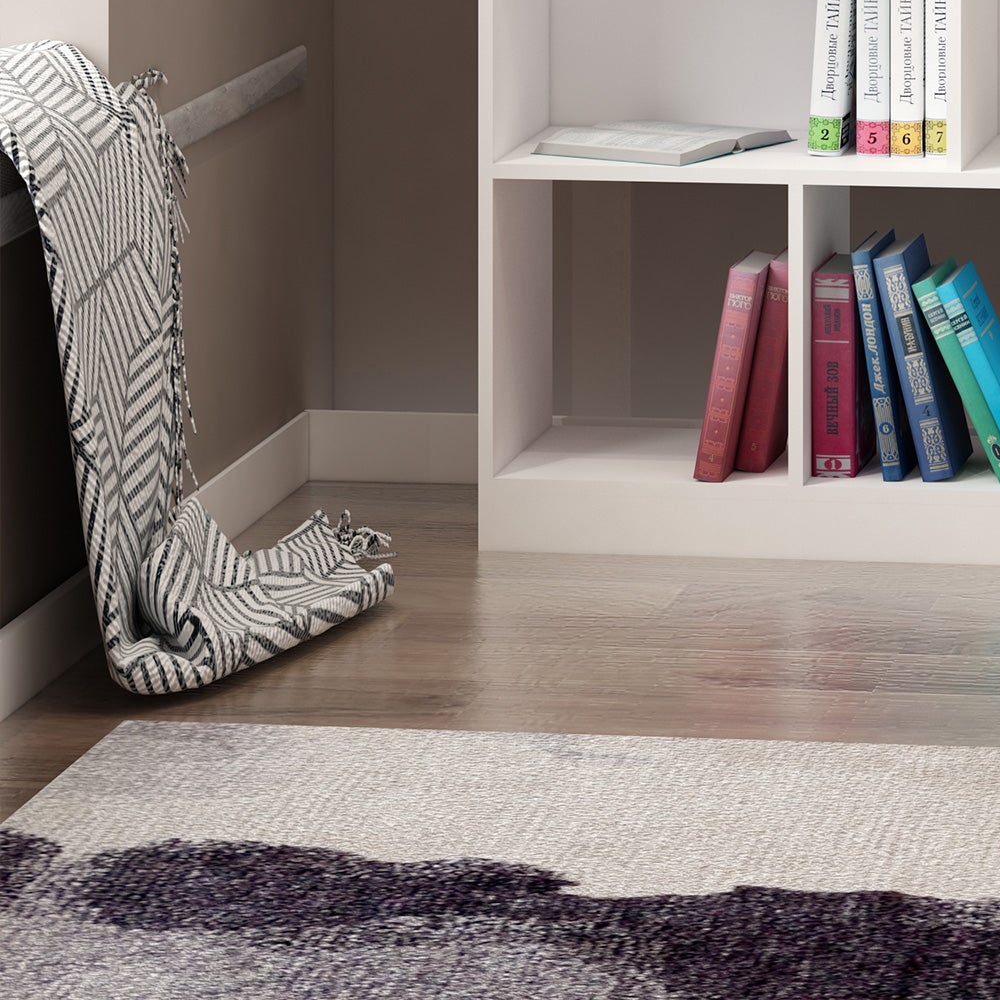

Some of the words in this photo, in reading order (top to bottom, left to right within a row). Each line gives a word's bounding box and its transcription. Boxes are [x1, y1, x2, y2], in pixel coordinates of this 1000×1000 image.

[820, 33, 840, 101] Дворцовые
[863, 35, 883, 103] Дворцовые
[899, 36, 916, 104] Дворцовые
[820, 128, 830, 141] 2
[867, 132, 877, 145] 5
[902, 133, 911, 145] 6
[936, 131, 944, 143] 7
[826, 361, 839, 382] ЗОВ
[824, 386, 839, 435] ВЕЧНЫЙ
[922, 405, 932, 417] 4
[882, 424, 889, 434] 6
[708, 453, 714, 463] 4
[994, 447, 1000, 457] 1
[830, 459, 836, 470] 1
